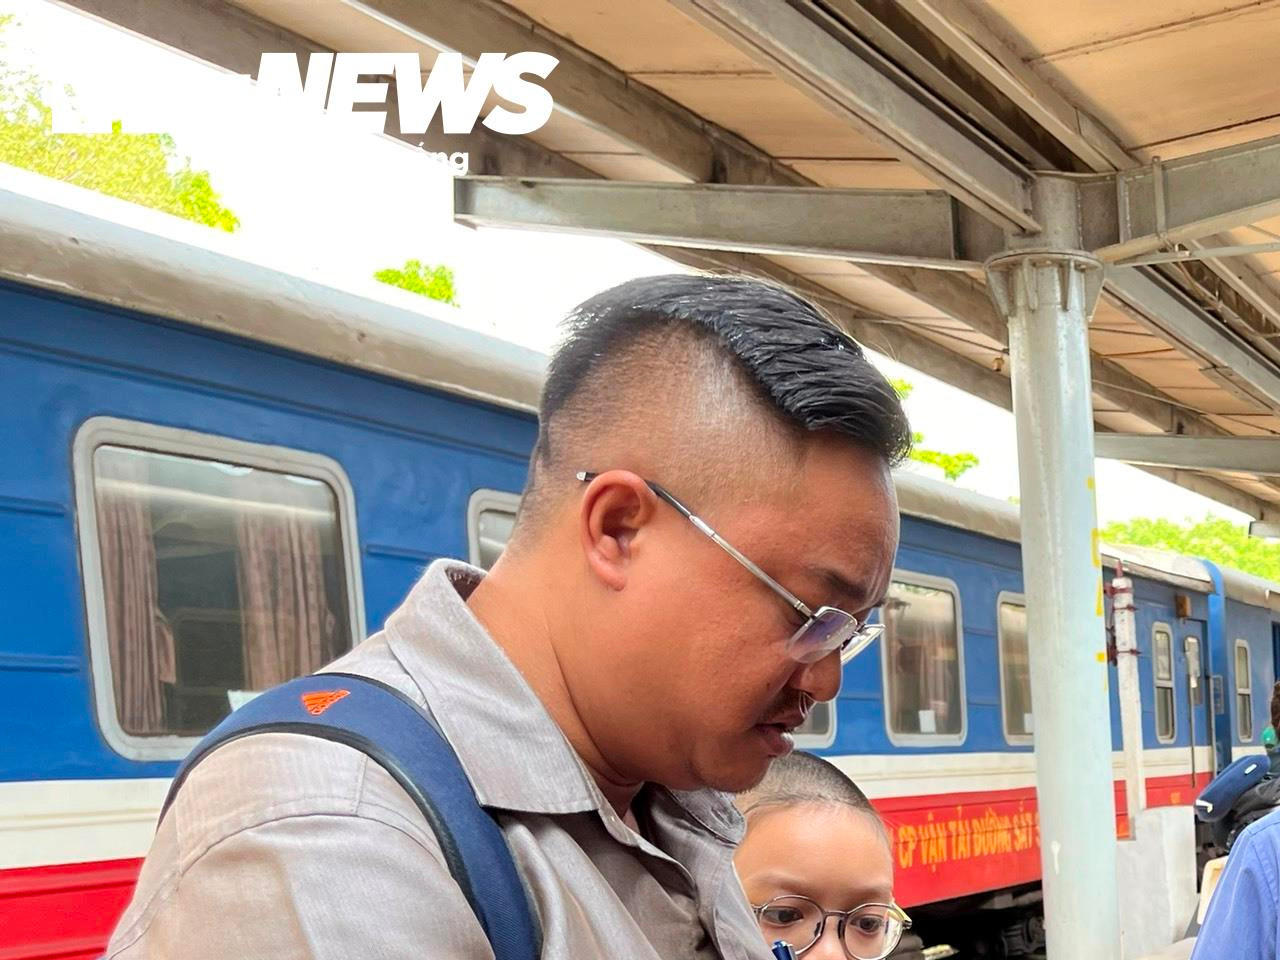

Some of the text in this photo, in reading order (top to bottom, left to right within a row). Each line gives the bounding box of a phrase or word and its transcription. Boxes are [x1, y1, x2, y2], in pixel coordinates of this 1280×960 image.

[899, 824, 917, 868] CP
[918, 811, 948, 873] VẬN
[948, 805, 971, 860] TẢI
[972, 805, 1012, 857] ĐƯỜNG
[1012, 799, 1033, 851] SẮT
